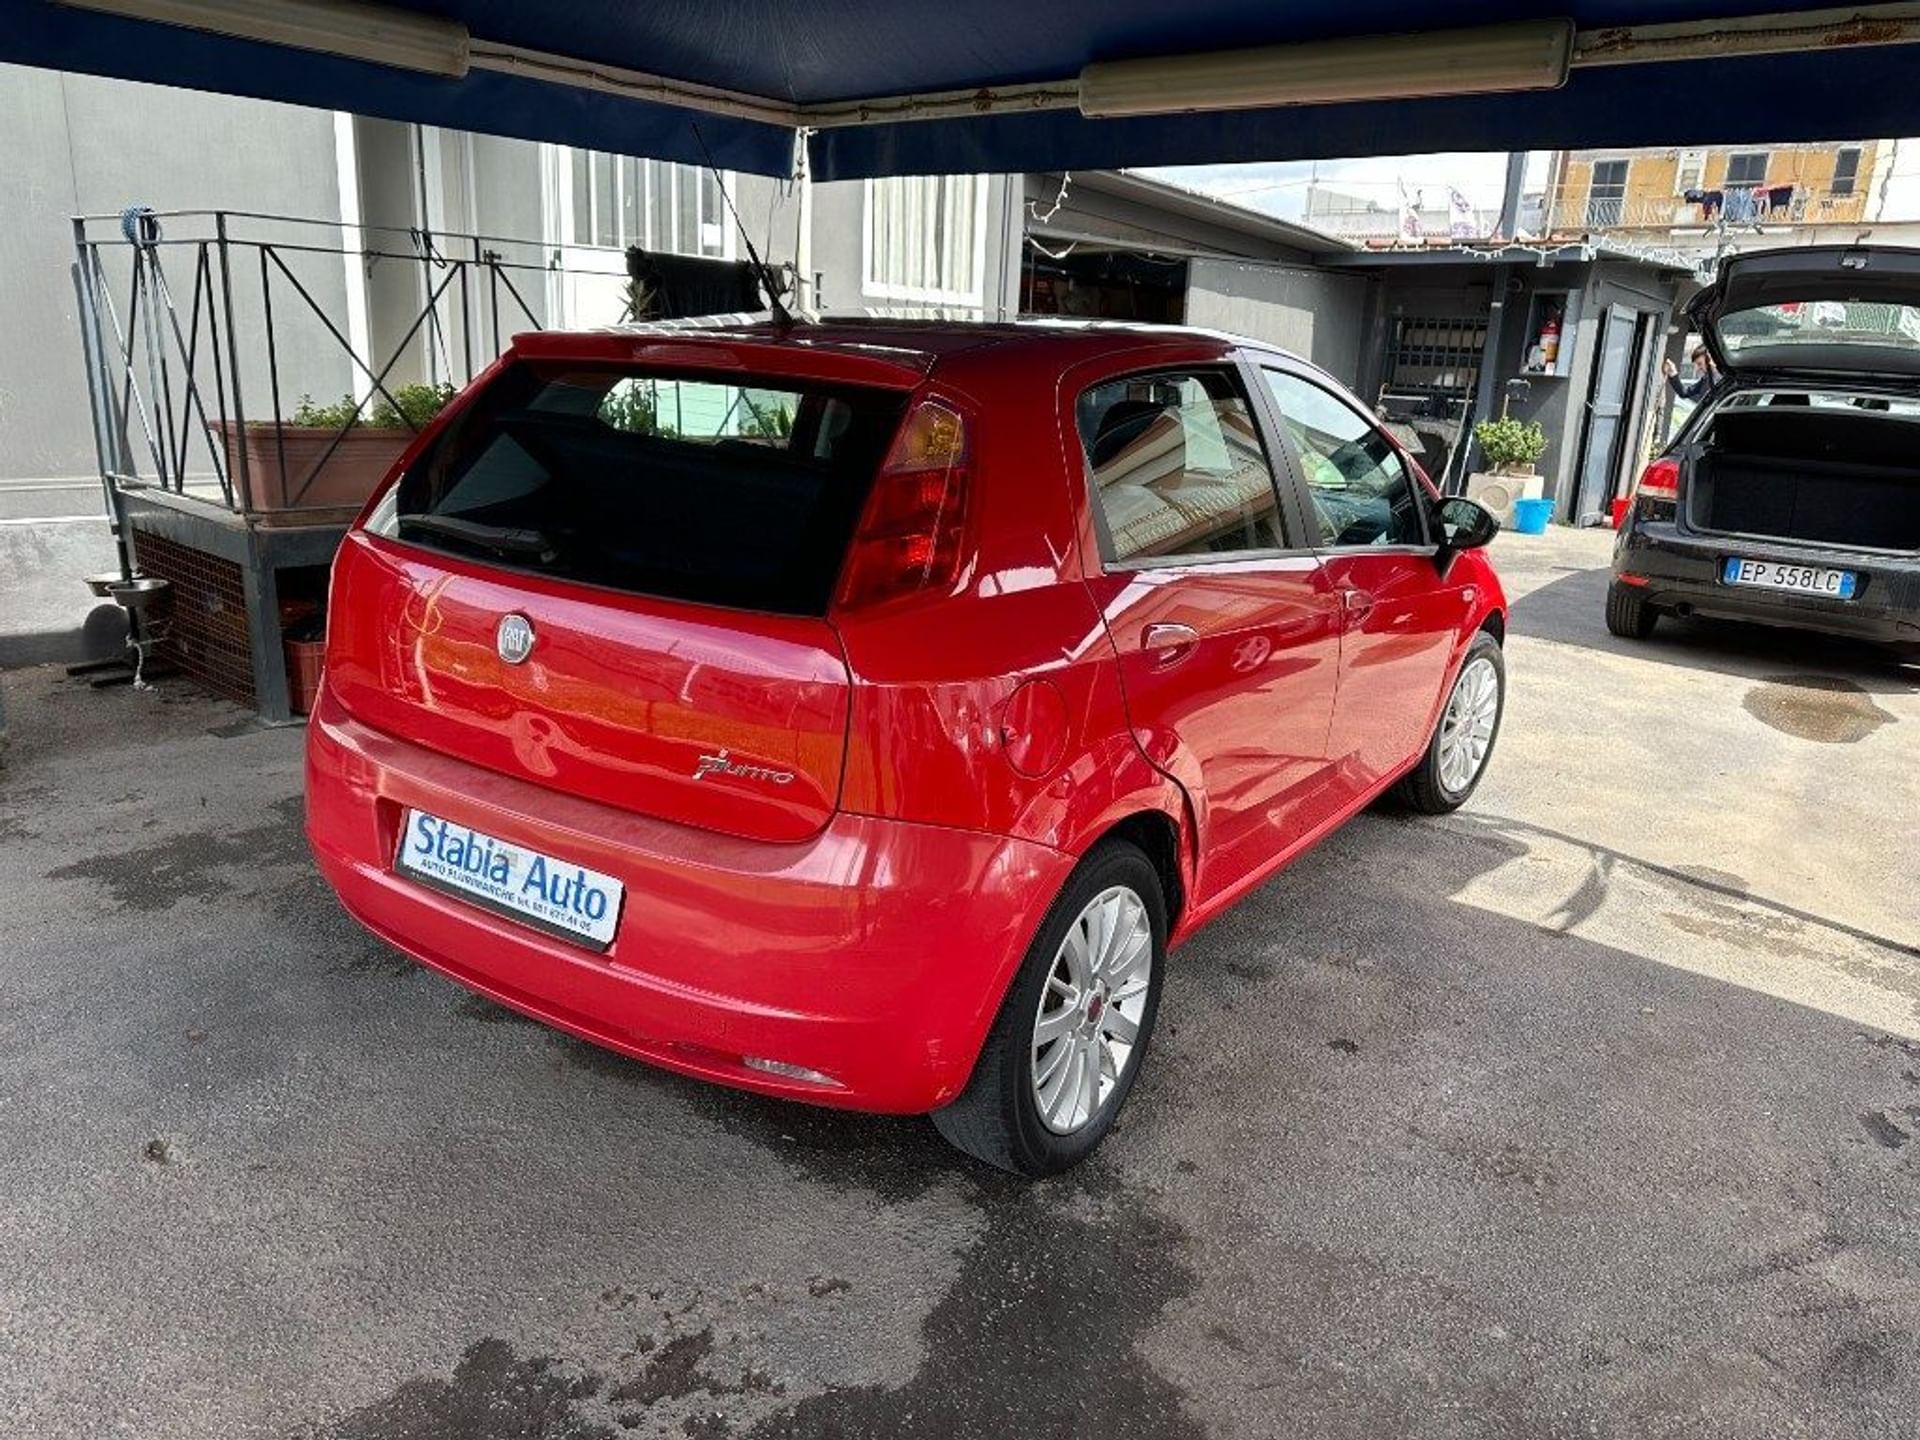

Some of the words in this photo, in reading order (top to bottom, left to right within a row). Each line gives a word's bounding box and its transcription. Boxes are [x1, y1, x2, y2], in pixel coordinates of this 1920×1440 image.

[1740, 562, 1766, 581] EP
[1773, 566, 1839, 592] 558LC
[504, 626, 526, 651] FIAT
[414, 815, 510, 886] Stabia
[521, 855, 608, 920] Auto
[421, 858, 446, 876] AUTO
